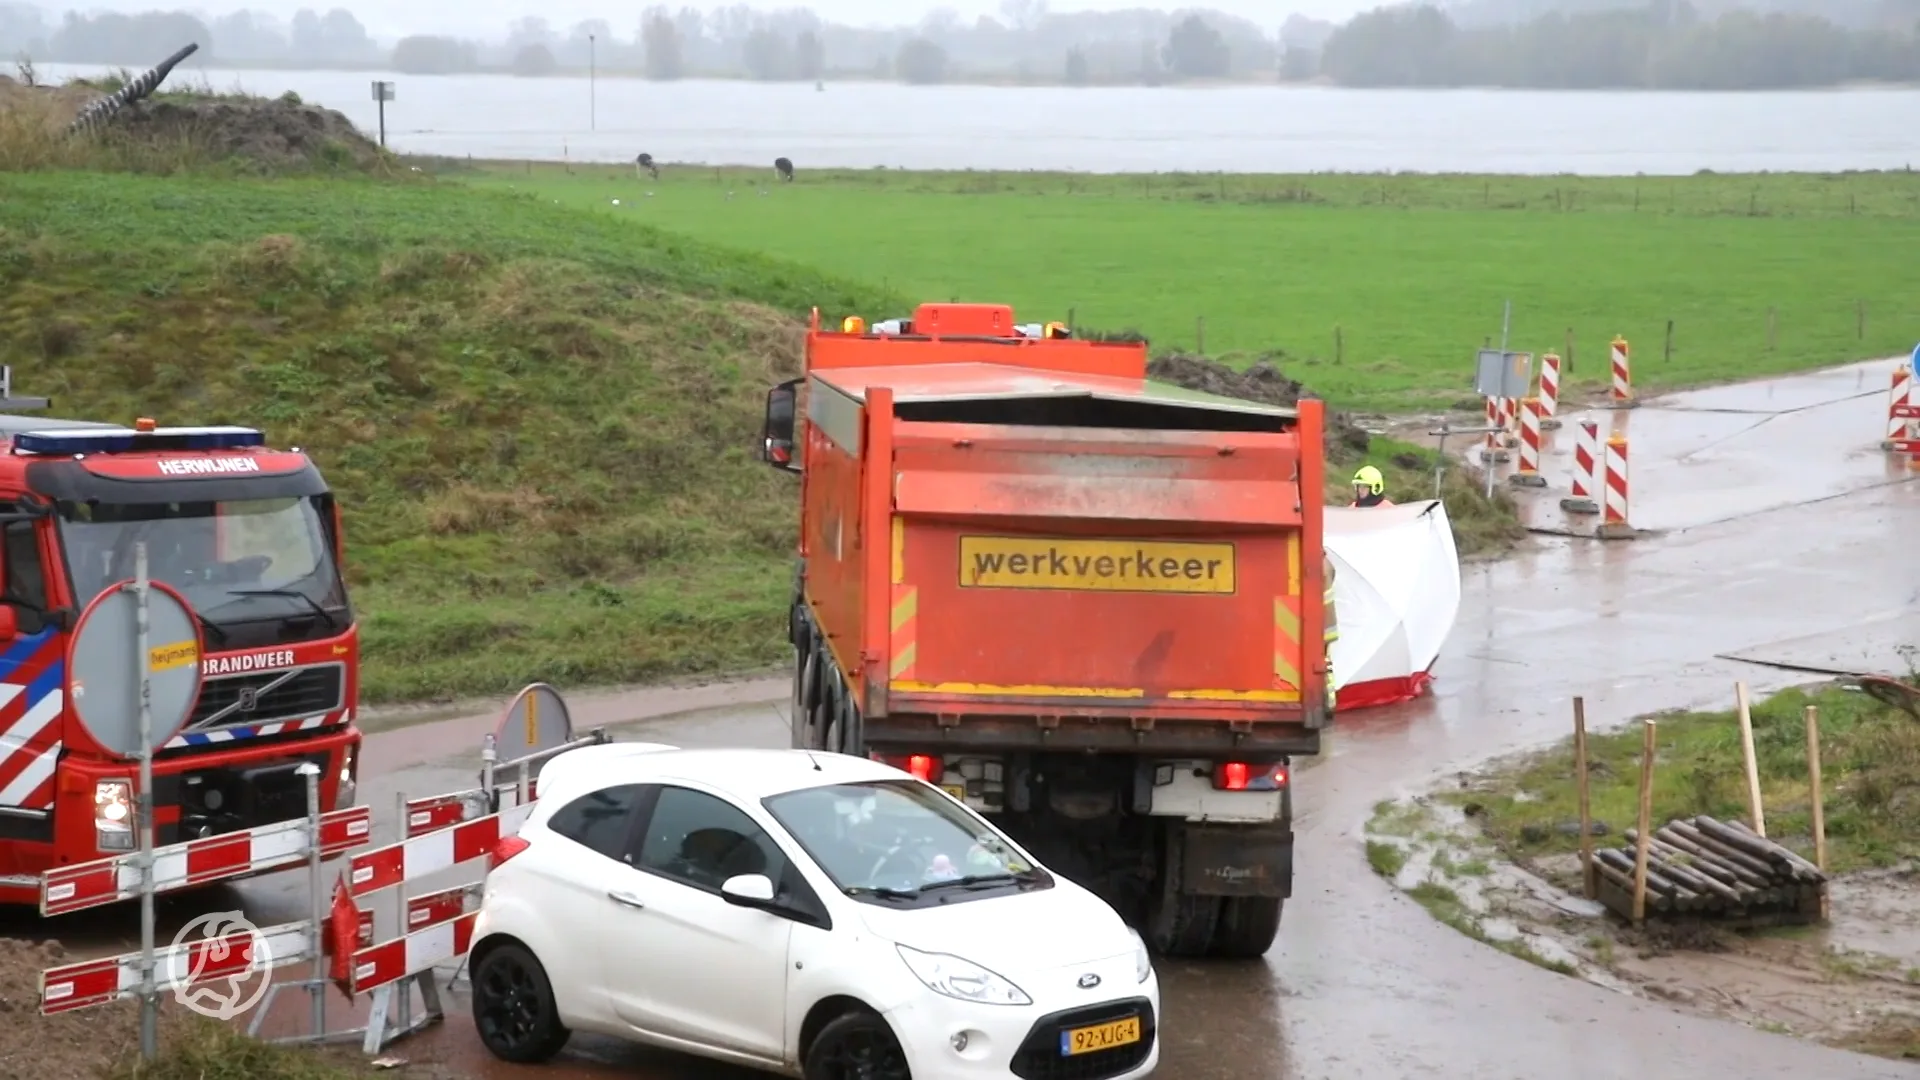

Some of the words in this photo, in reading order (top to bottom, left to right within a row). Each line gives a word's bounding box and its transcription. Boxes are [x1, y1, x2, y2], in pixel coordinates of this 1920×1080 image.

[157, 457, 260, 475] HERWIJNEN
[973, 547, 1222, 580] werkverkeer
[1075, 1022, 1135, 1050] 92-XJG-4
